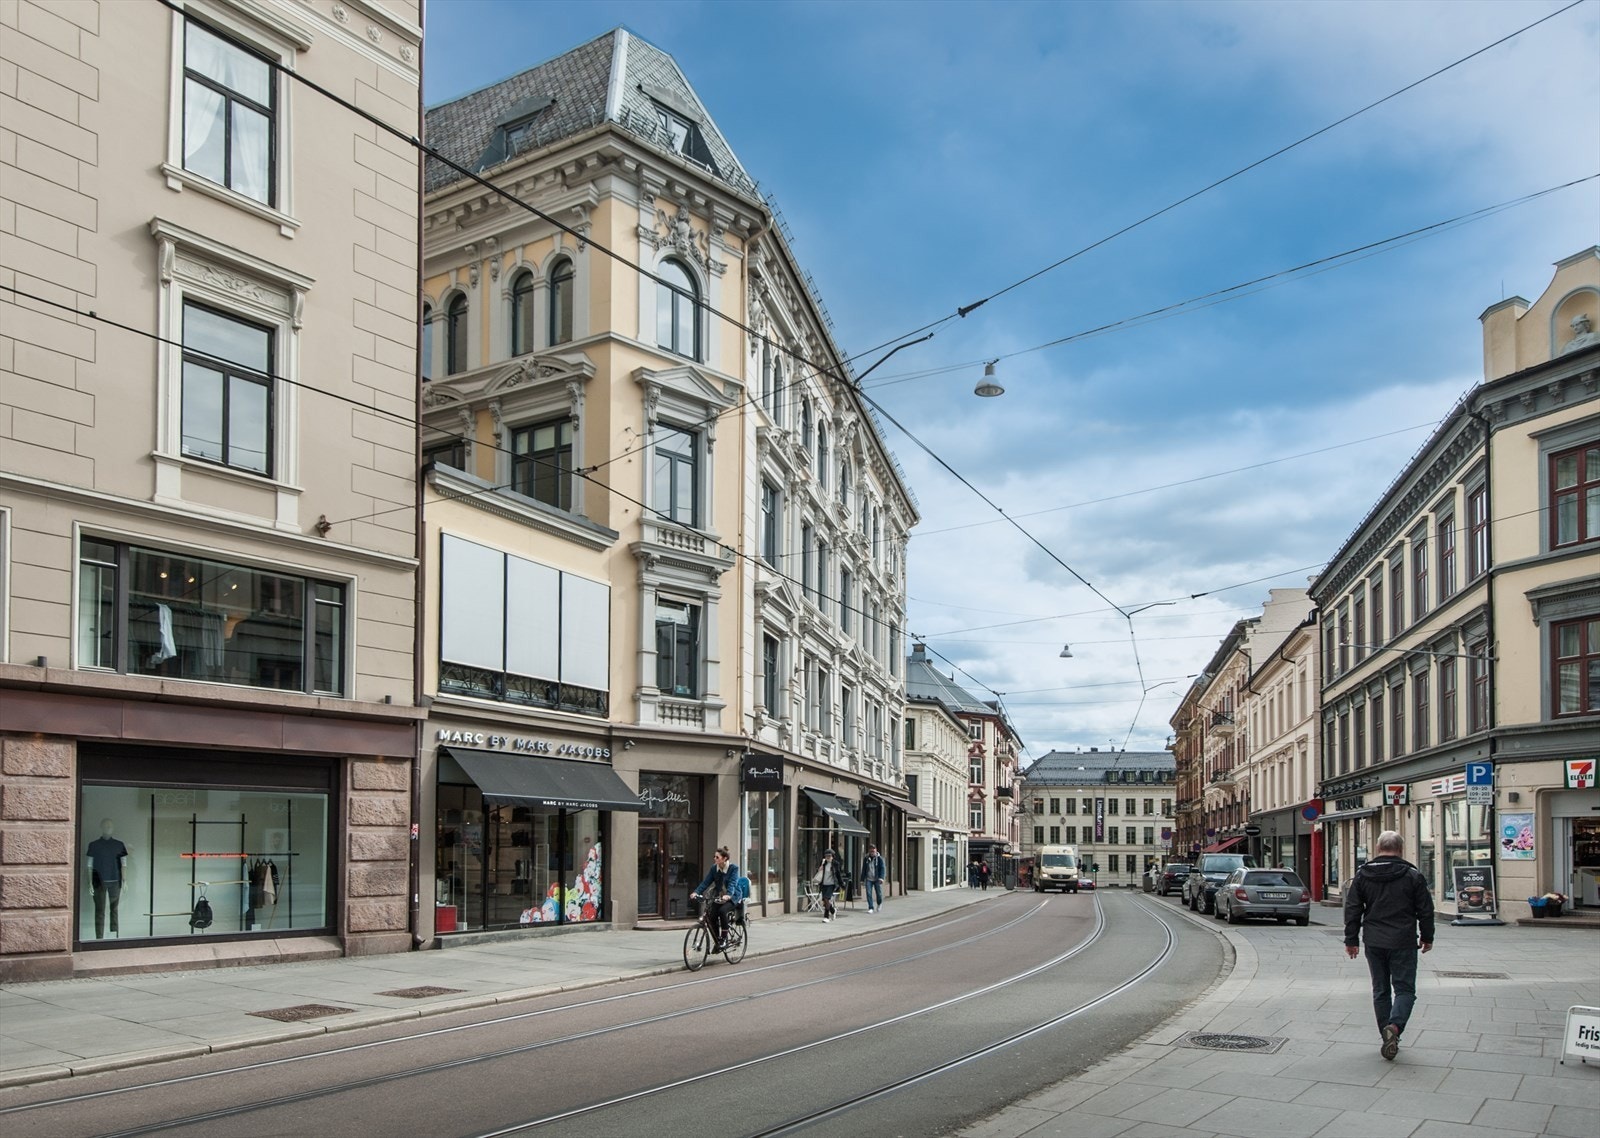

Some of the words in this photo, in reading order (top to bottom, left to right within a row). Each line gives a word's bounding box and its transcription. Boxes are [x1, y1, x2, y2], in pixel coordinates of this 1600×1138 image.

[439, 730, 484, 744] MARC
[489, 736, 508, 747] BY
[514, 738, 553, 752] MARC
[558, 743, 611, 758] JACOBS
[1473, 765, 1486, 782] P
[1570, 762, 1592, 788] 7
[1576, 1042, 1590, 1050] ledig
